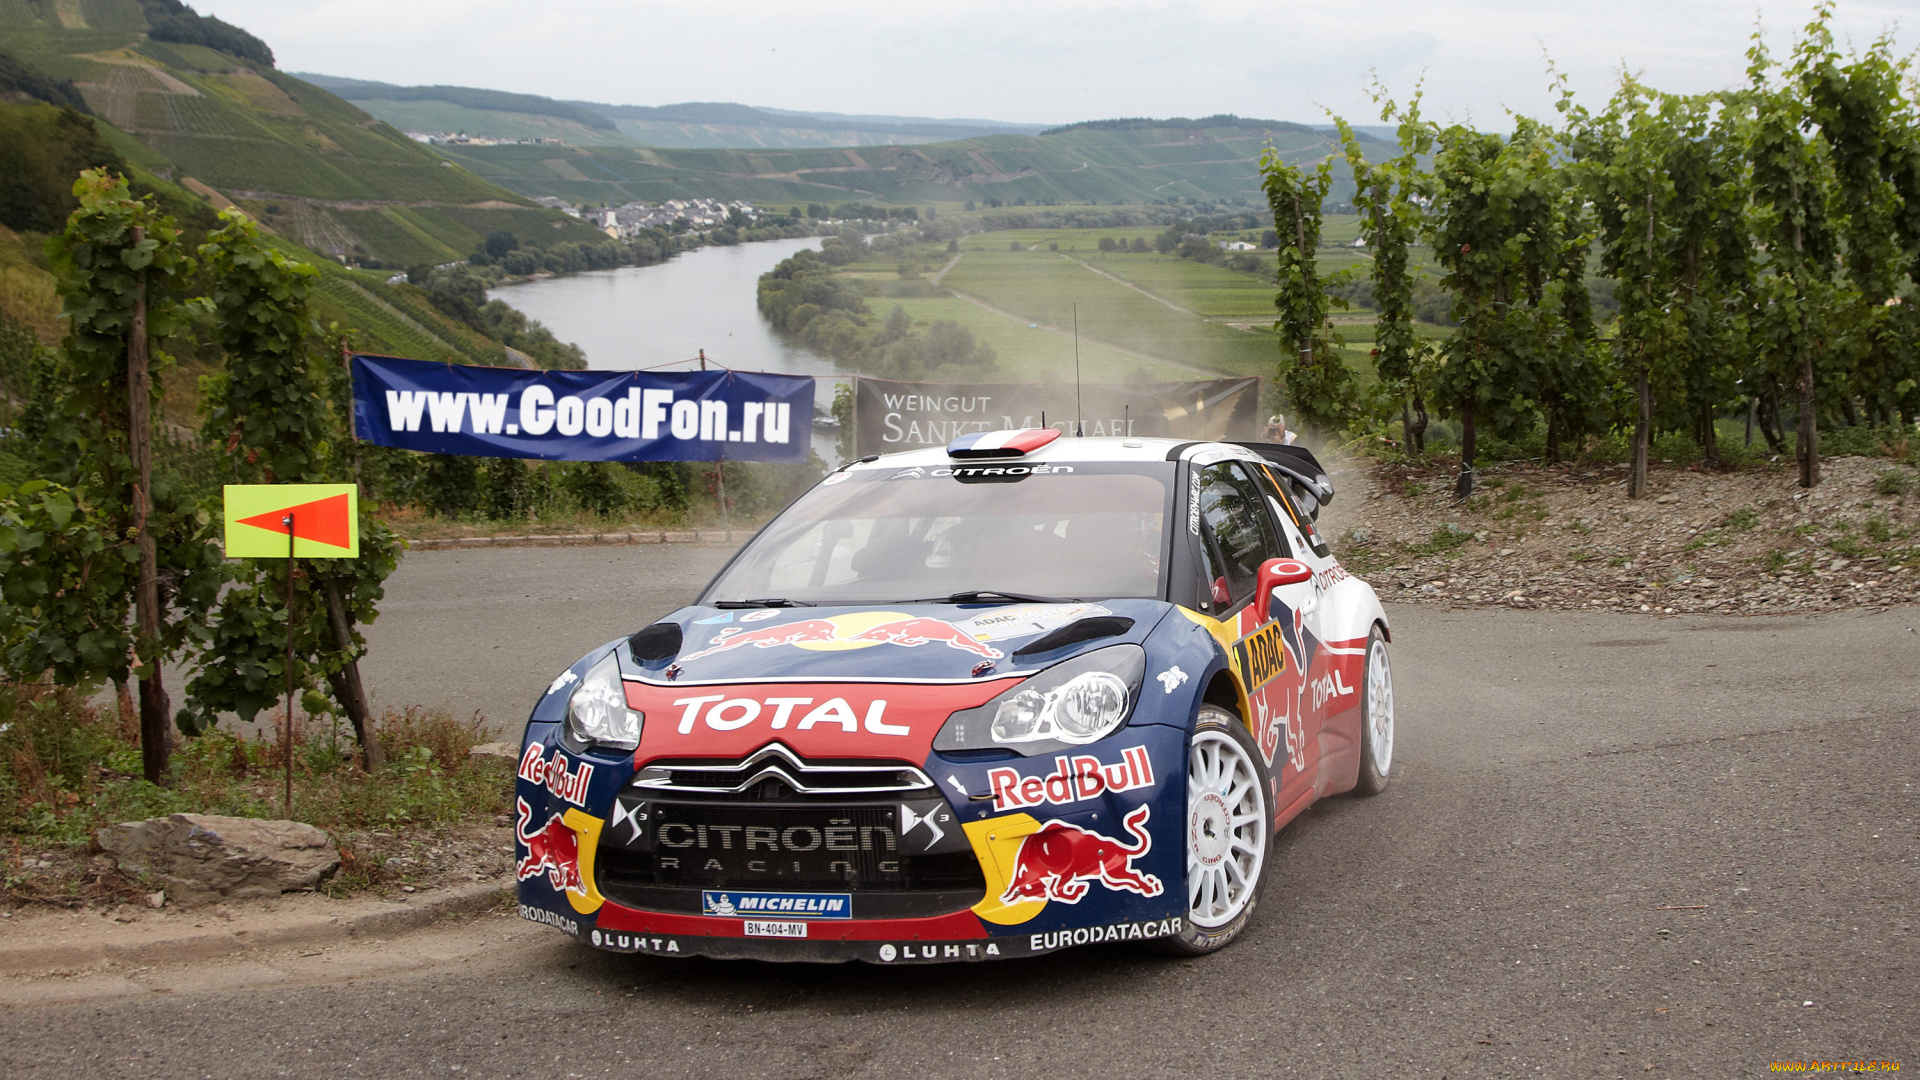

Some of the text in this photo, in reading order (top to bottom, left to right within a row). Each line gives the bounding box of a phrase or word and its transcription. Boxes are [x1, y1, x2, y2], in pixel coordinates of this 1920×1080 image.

[883, 393, 991, 412] WEINGUT
[386, 385, 790, 443] www.GoodFon.ru
[1001, 415, 1136, 437] MCHAEL
[930, 462, 1074, 478] CITROËN
[974, 615, 1016, 627] ADAC
[1249, 624, 1284, 687] ADAC
[1311, 669, 1354, 713] TOTAL
[673, 694, 910, 736] TOTAL
[658, 818, 897, 851] CITROËN
[661, 857, 899, 873] RACING
[739, 897, 844, 912] MICHELIN
[747, 922, 804, 937] BN-404-MV
[1030, 917, 1182, 951] EURODATACAR
[604, 933, 680, 953] LUHTA
[903, 942, 1001, 959] LUHTA
